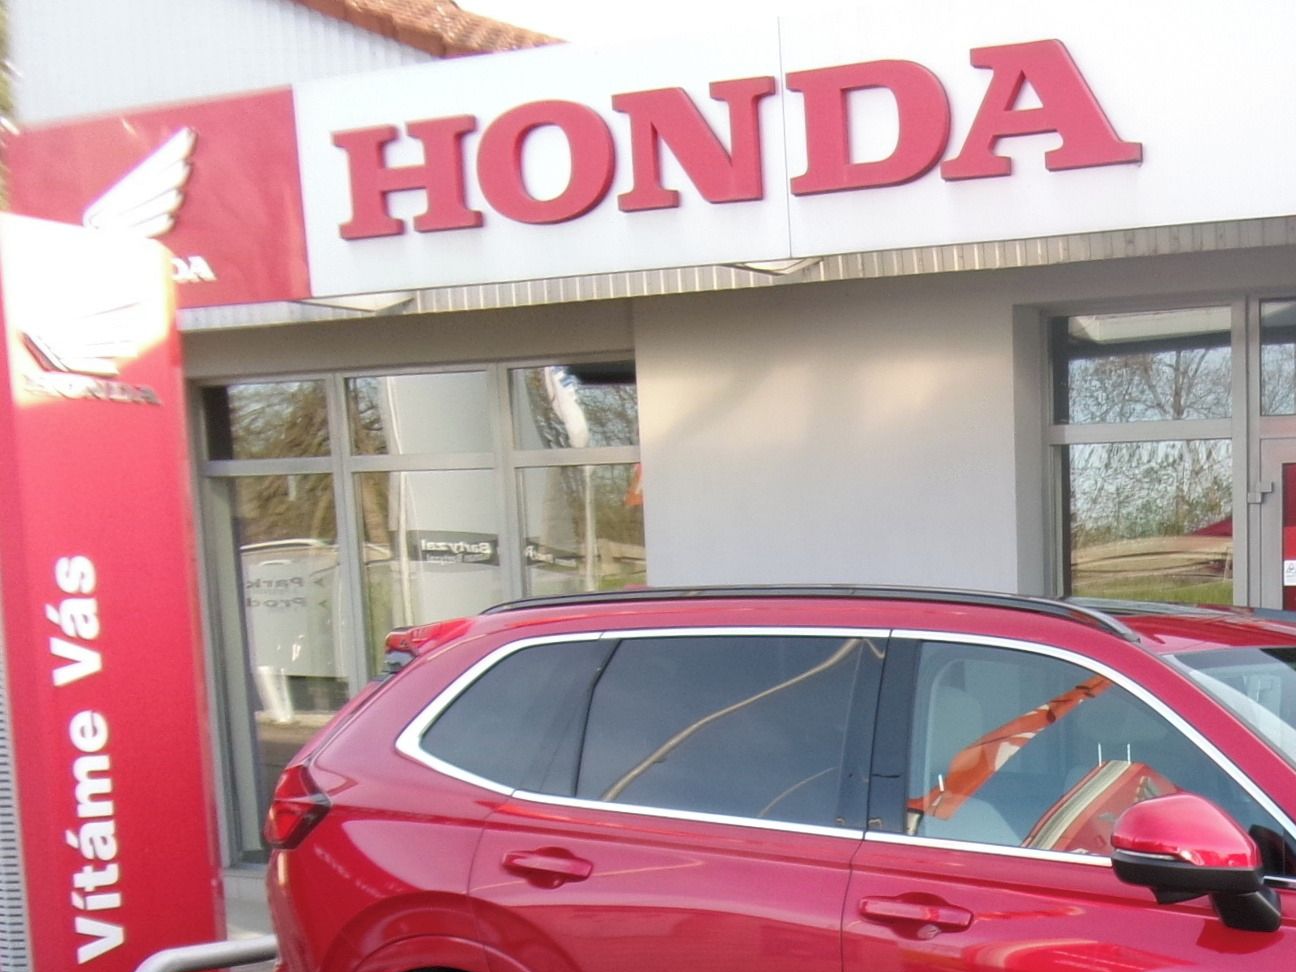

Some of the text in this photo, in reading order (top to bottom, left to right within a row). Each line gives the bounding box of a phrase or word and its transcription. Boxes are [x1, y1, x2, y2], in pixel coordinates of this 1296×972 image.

[331, 37, 1143, 241] HONDA
[45, 554, 125, 965] Vítáme Vás
